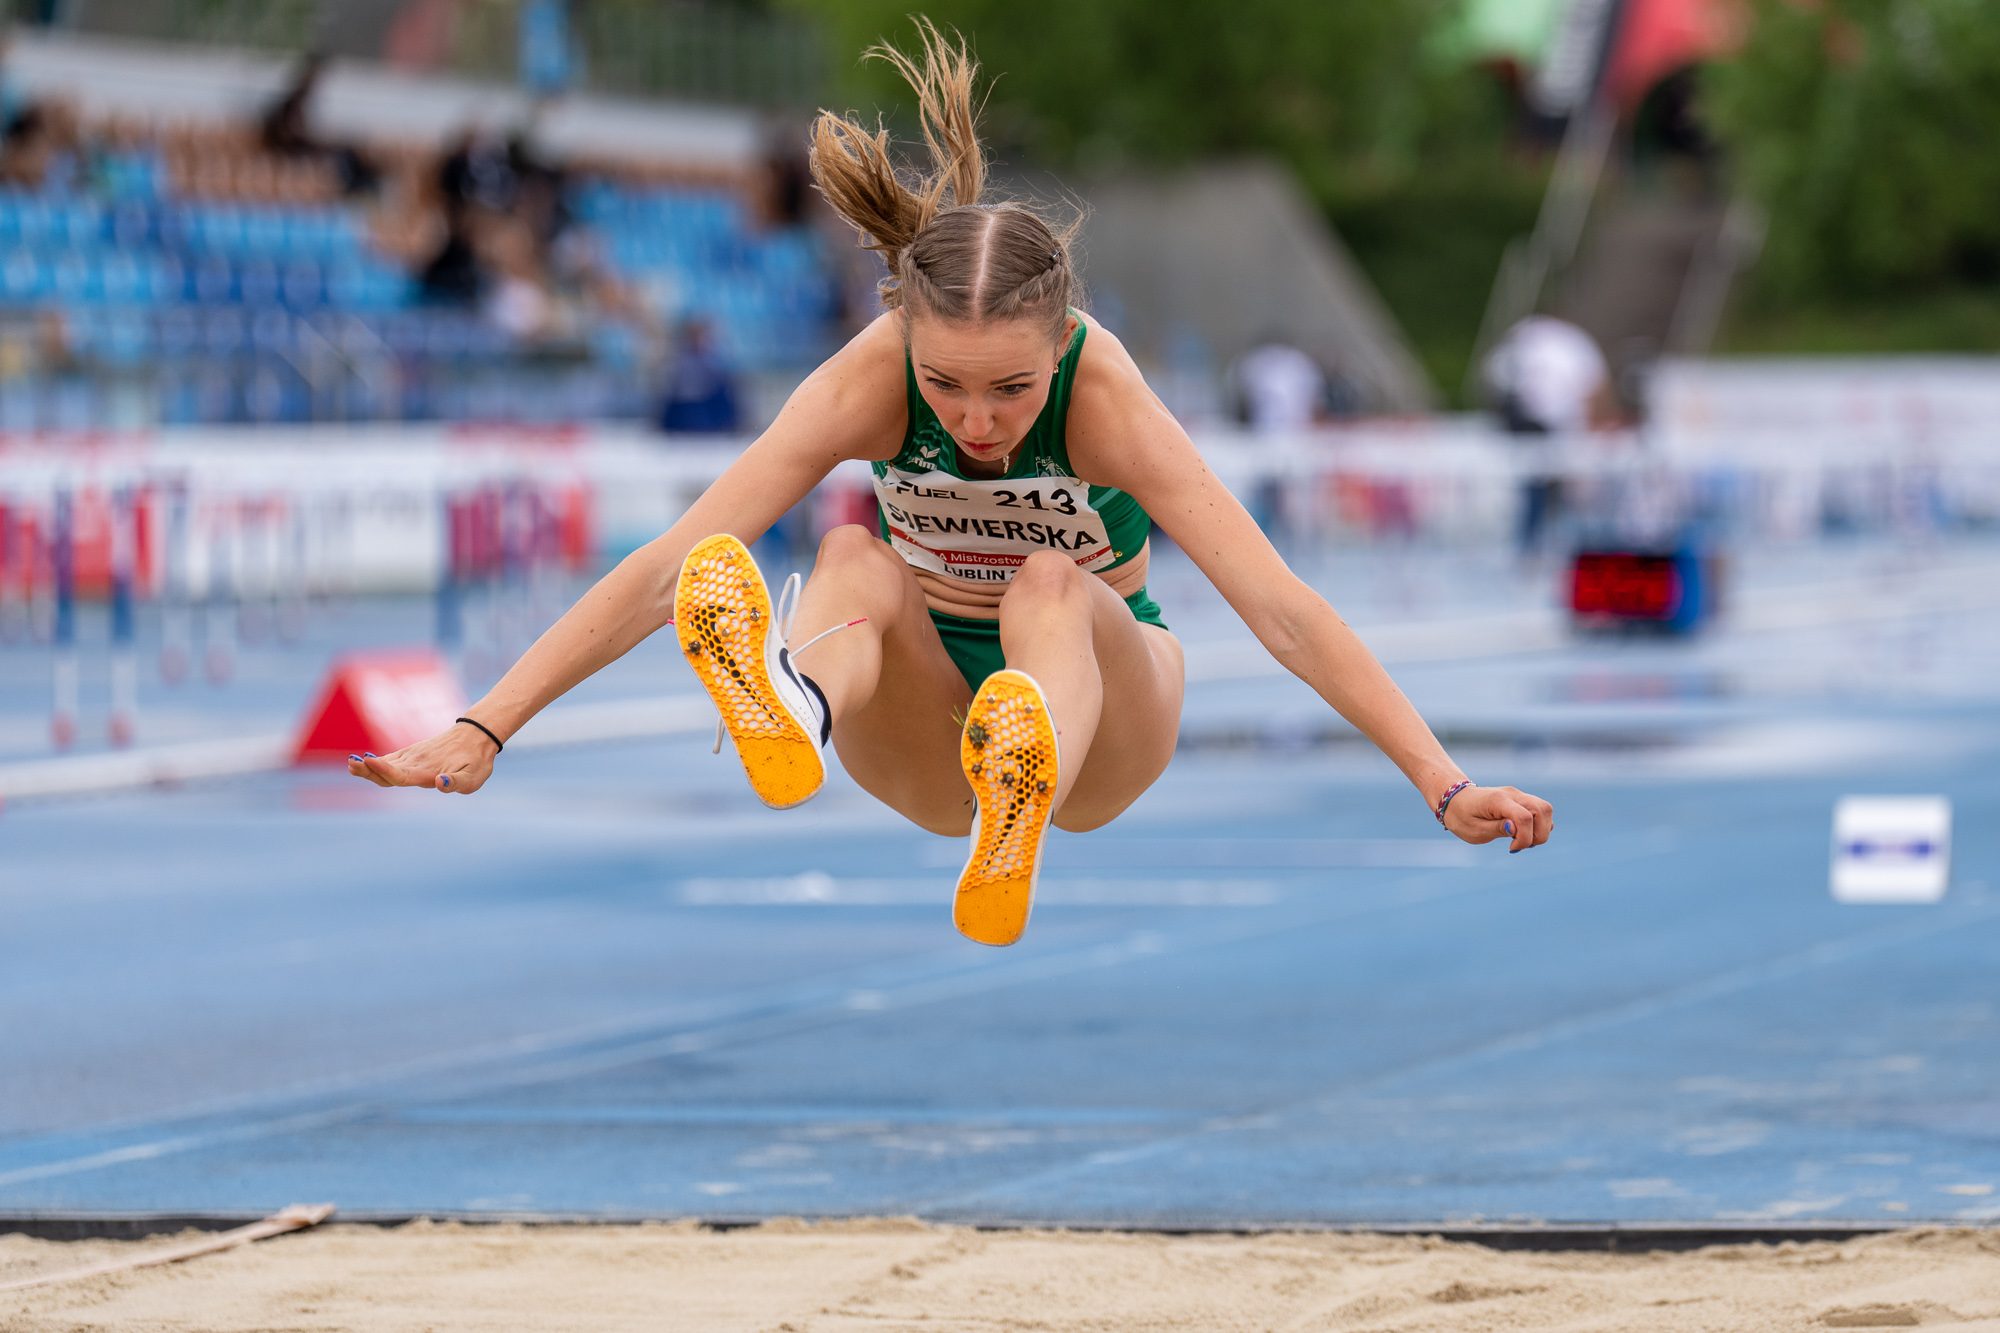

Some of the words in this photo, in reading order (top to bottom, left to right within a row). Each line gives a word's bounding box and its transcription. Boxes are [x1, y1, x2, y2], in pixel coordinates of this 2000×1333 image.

[896, 480, 969, 501] FUEL
[992, 488, 1077, 516] 213
[886, 501, 1099, 550] SIEWIERSKA
[943, 563, 1006, 581] LUBLIN
